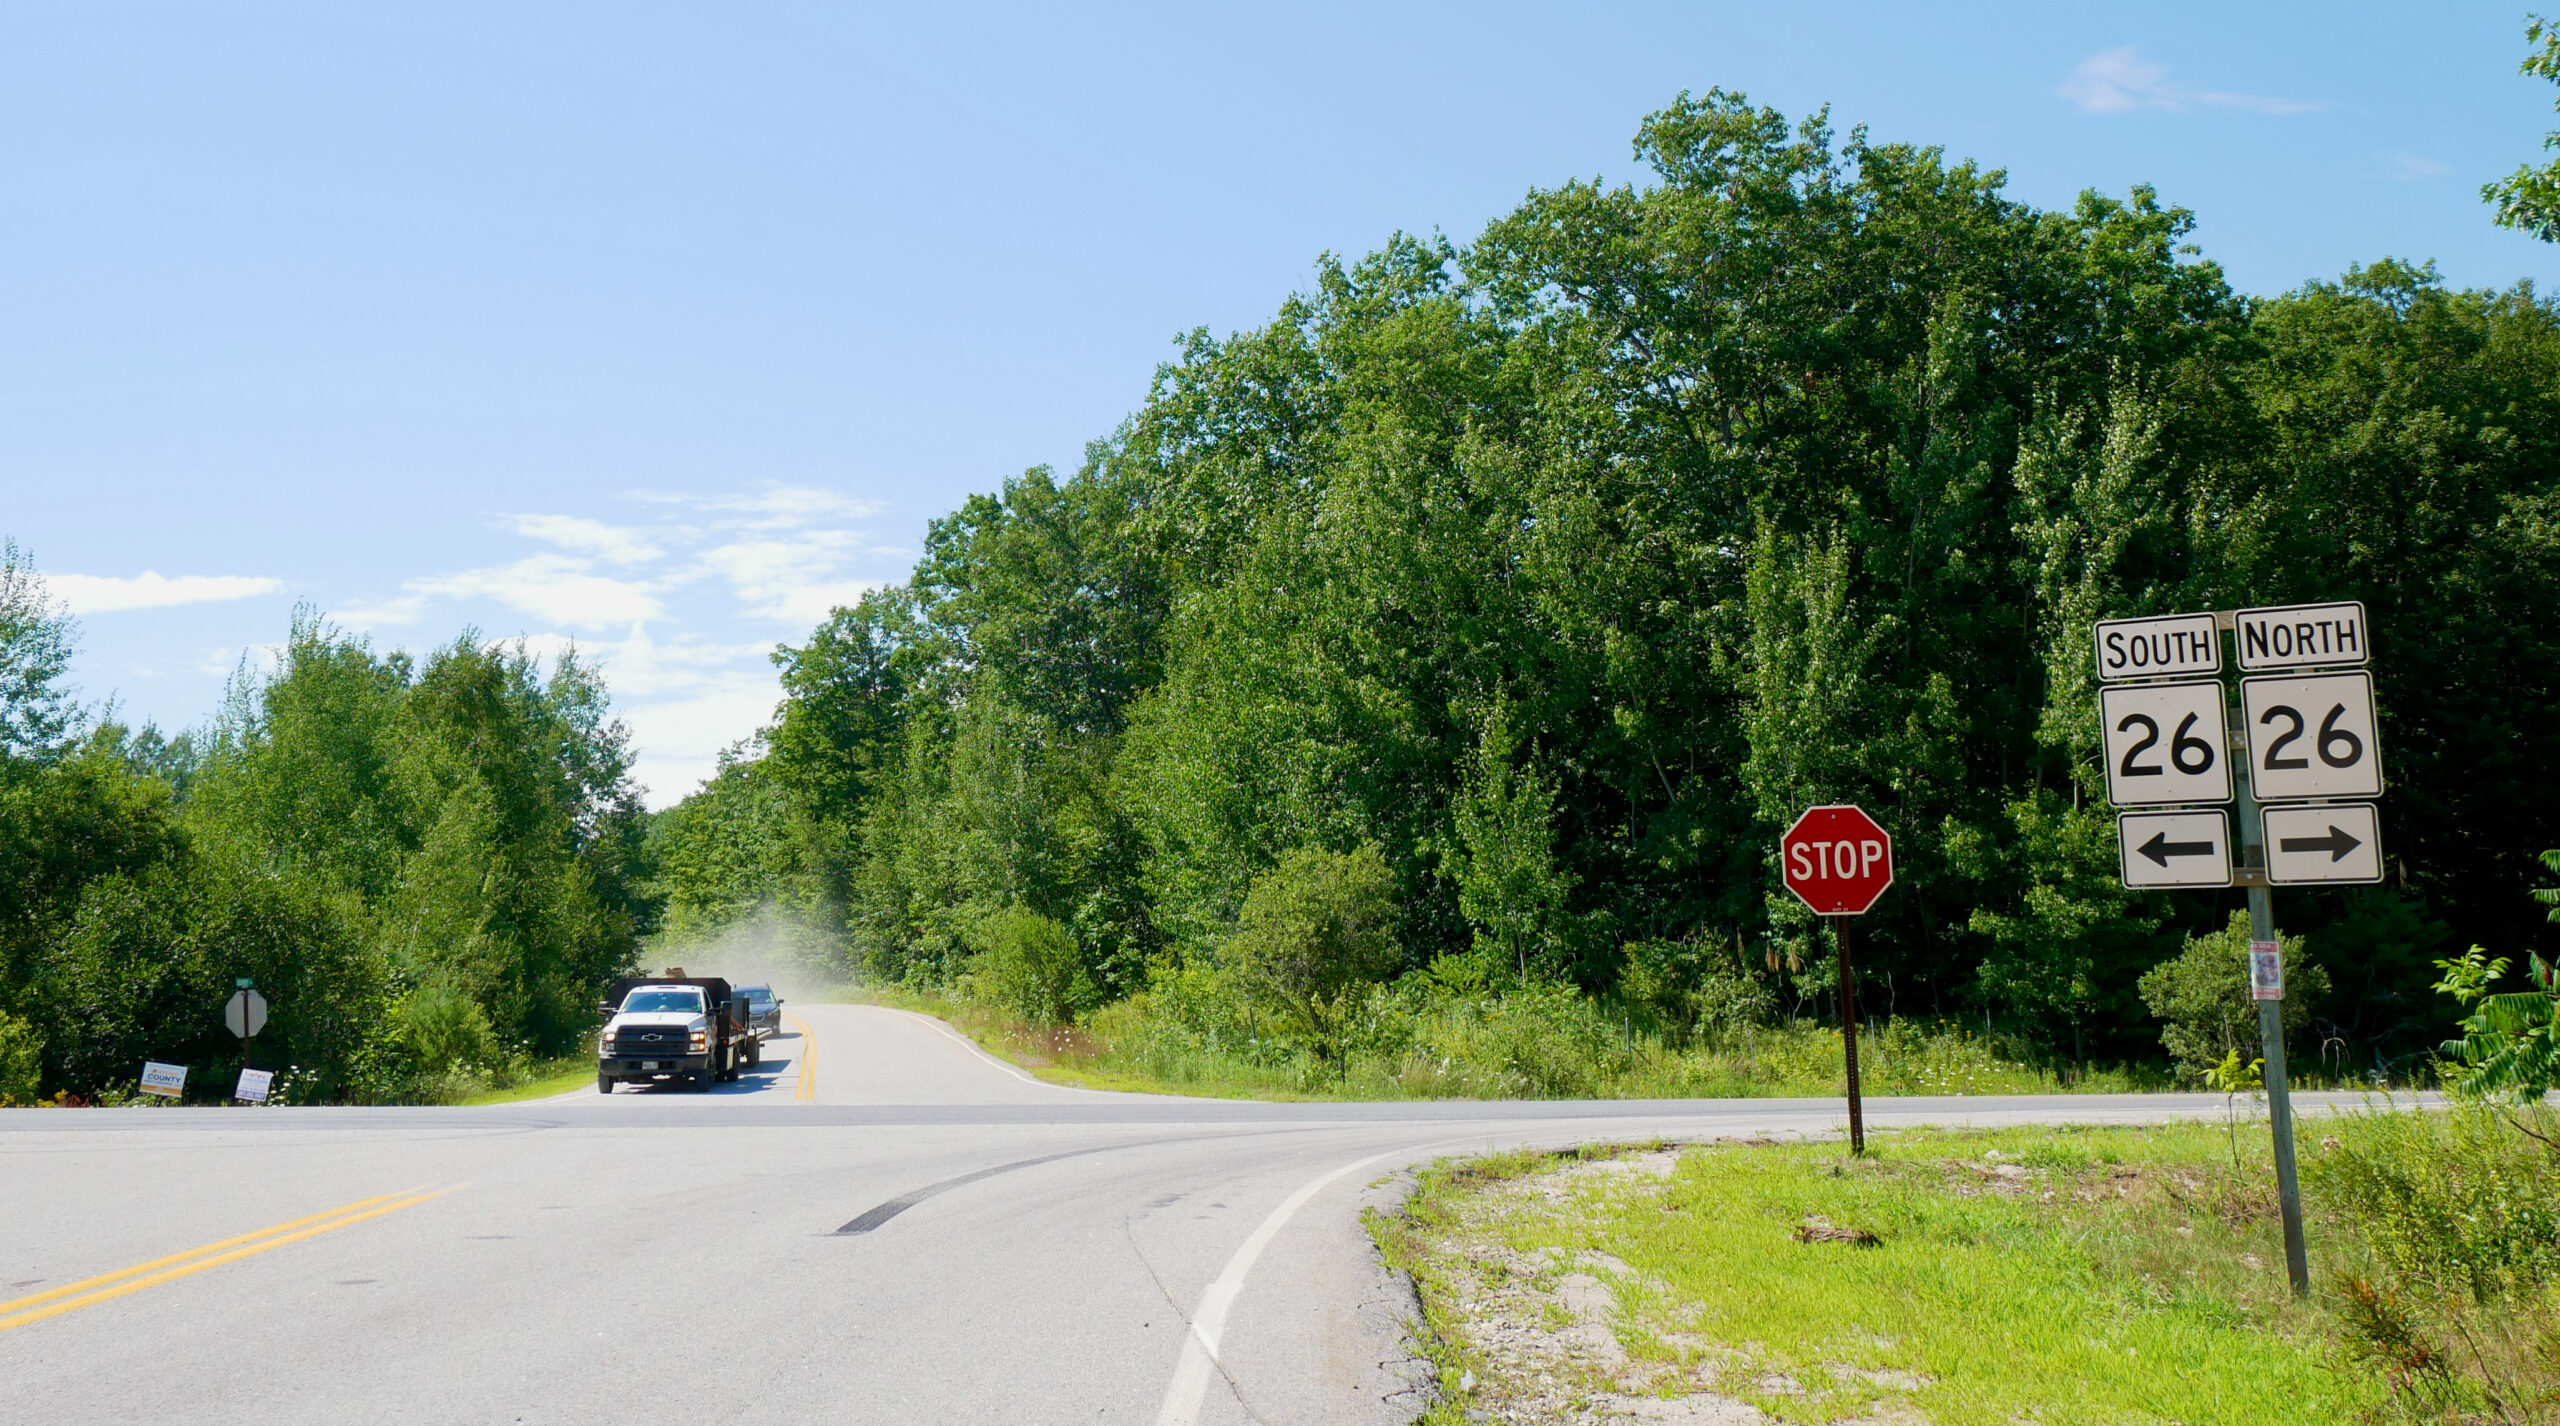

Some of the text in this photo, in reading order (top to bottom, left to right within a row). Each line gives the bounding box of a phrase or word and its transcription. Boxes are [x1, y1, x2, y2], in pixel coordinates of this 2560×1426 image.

[2106, 630, 2211, 668] SOUTH
[2245, 619, 2357, 658] NORTH
[2117, 711, 2214, 776] 26
[2261, 702, 2363, 769] 26
[1791, 840, 1883, 881] STOP
[147, 1073, 181, 1082] COUNTY
